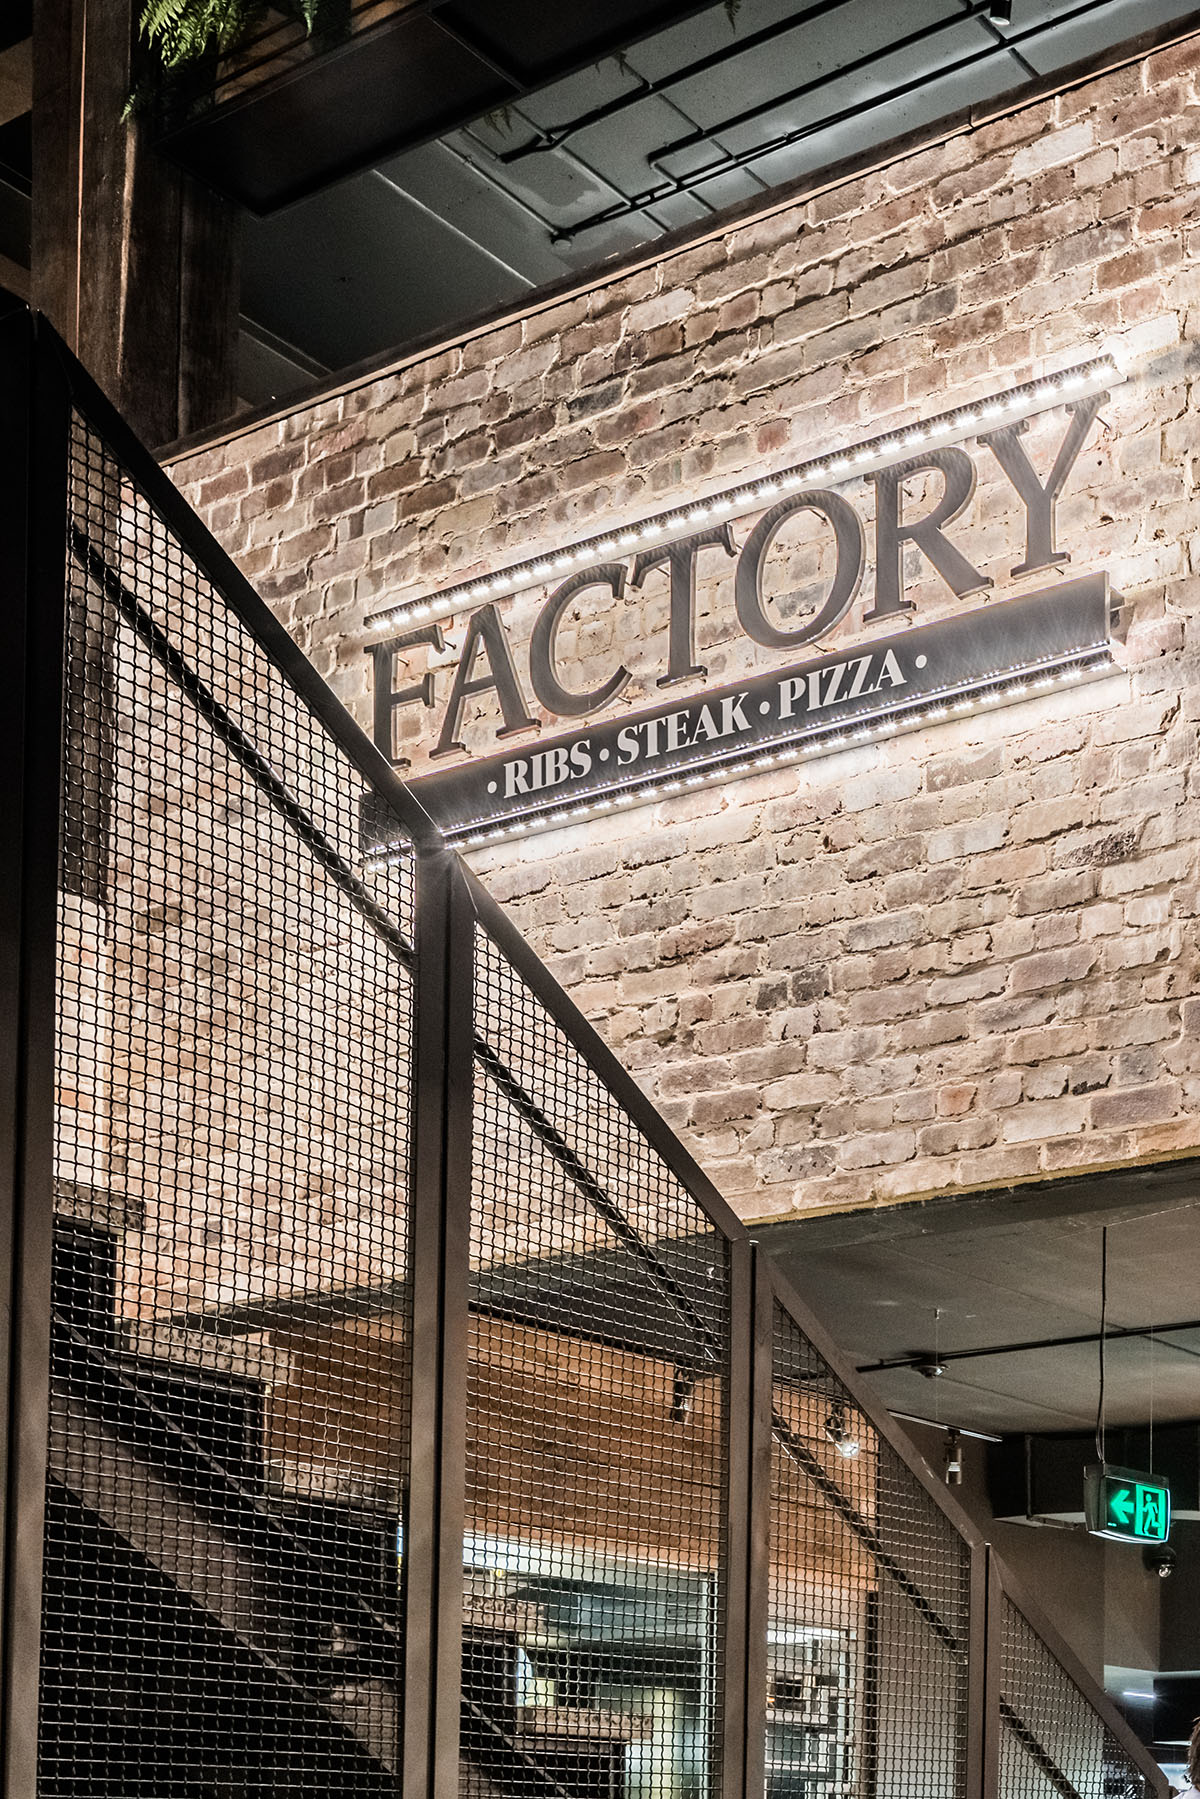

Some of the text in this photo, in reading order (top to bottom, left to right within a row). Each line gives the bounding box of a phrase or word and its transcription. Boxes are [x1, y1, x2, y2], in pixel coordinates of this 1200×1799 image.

[364, 390, 1111, 768] FACTORY
[503, 648, 908, 799] RIBS STEAK PIZZA
